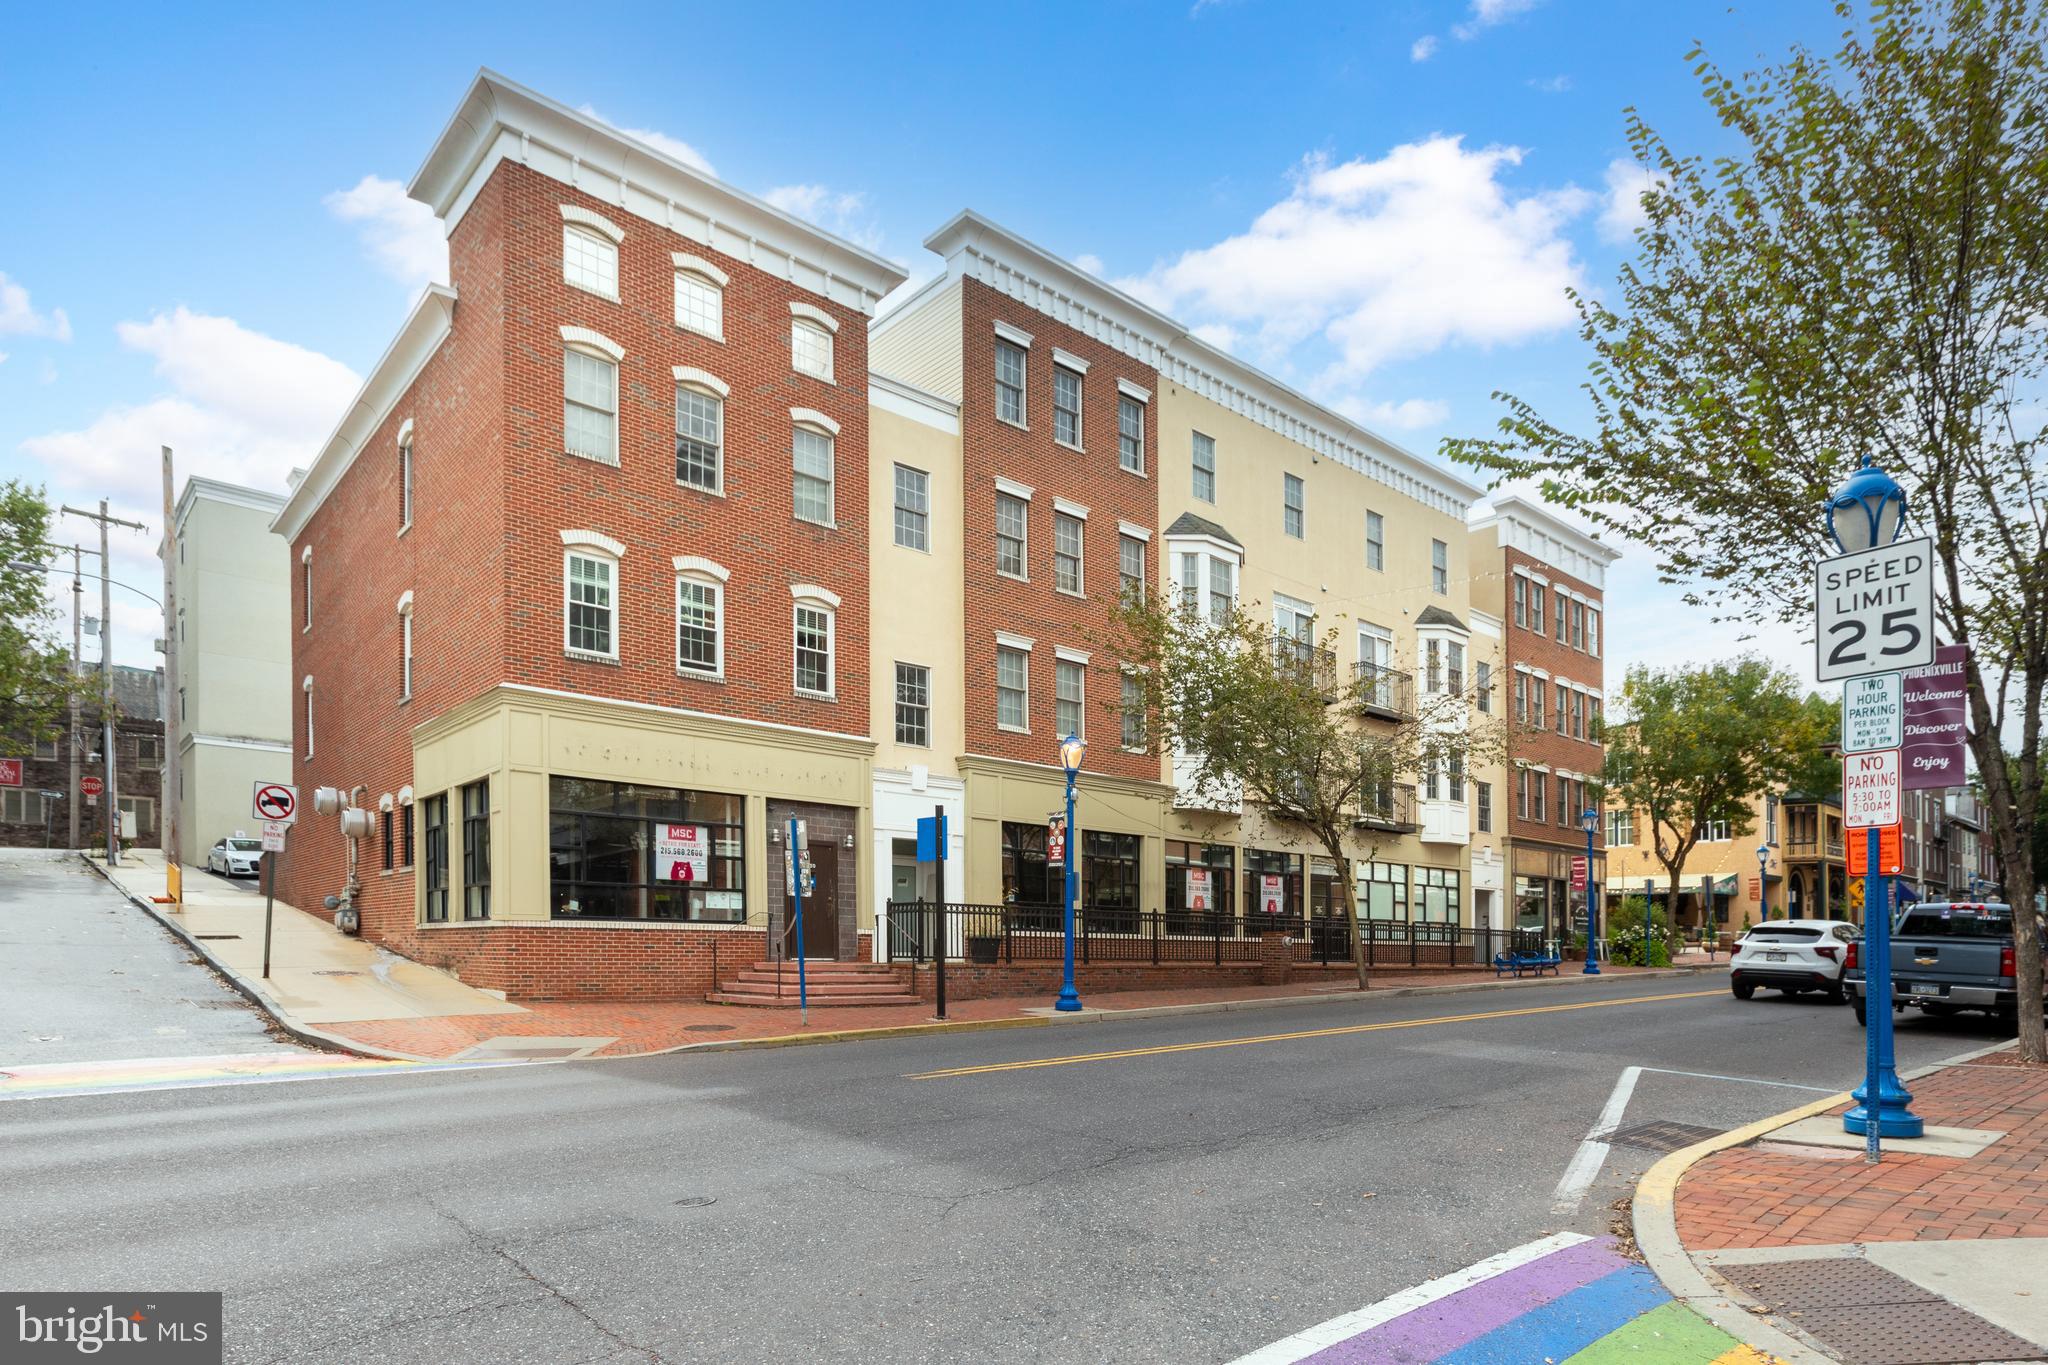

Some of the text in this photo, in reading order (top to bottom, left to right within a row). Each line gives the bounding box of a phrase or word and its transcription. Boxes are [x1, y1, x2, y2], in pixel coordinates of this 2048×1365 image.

[1826, 555, 1922, 591] SPEED
[1836, 583, 1911, 614] LIMIT
[1828, 608, 1921, 666] 25
[1903, 662, 1964, 679] PHOENIXVILLE
[1861, 679, 1884, 691] TWO
[1857, 692, 1888, 705] HOUR
[1903, 689, 1964, 702] Welcome
[1849, 704, 1896, 719] PARKING
[1870, 717, 1890, 727] BLOCK
[1904, 723, 1962, 735] Discover
[1861, 756, 1884, 771] NO
[1912, 757, 1950, 770] Enjoy
[82, 782, 102, 790] STOP
[1848, 771, 1896, 789] PARKING
[1853, 789, 1891, 803] 5:30 TO
[1853, 800, 1891, 813] 7:00AM
[671, 828, 693, 839] MSC
